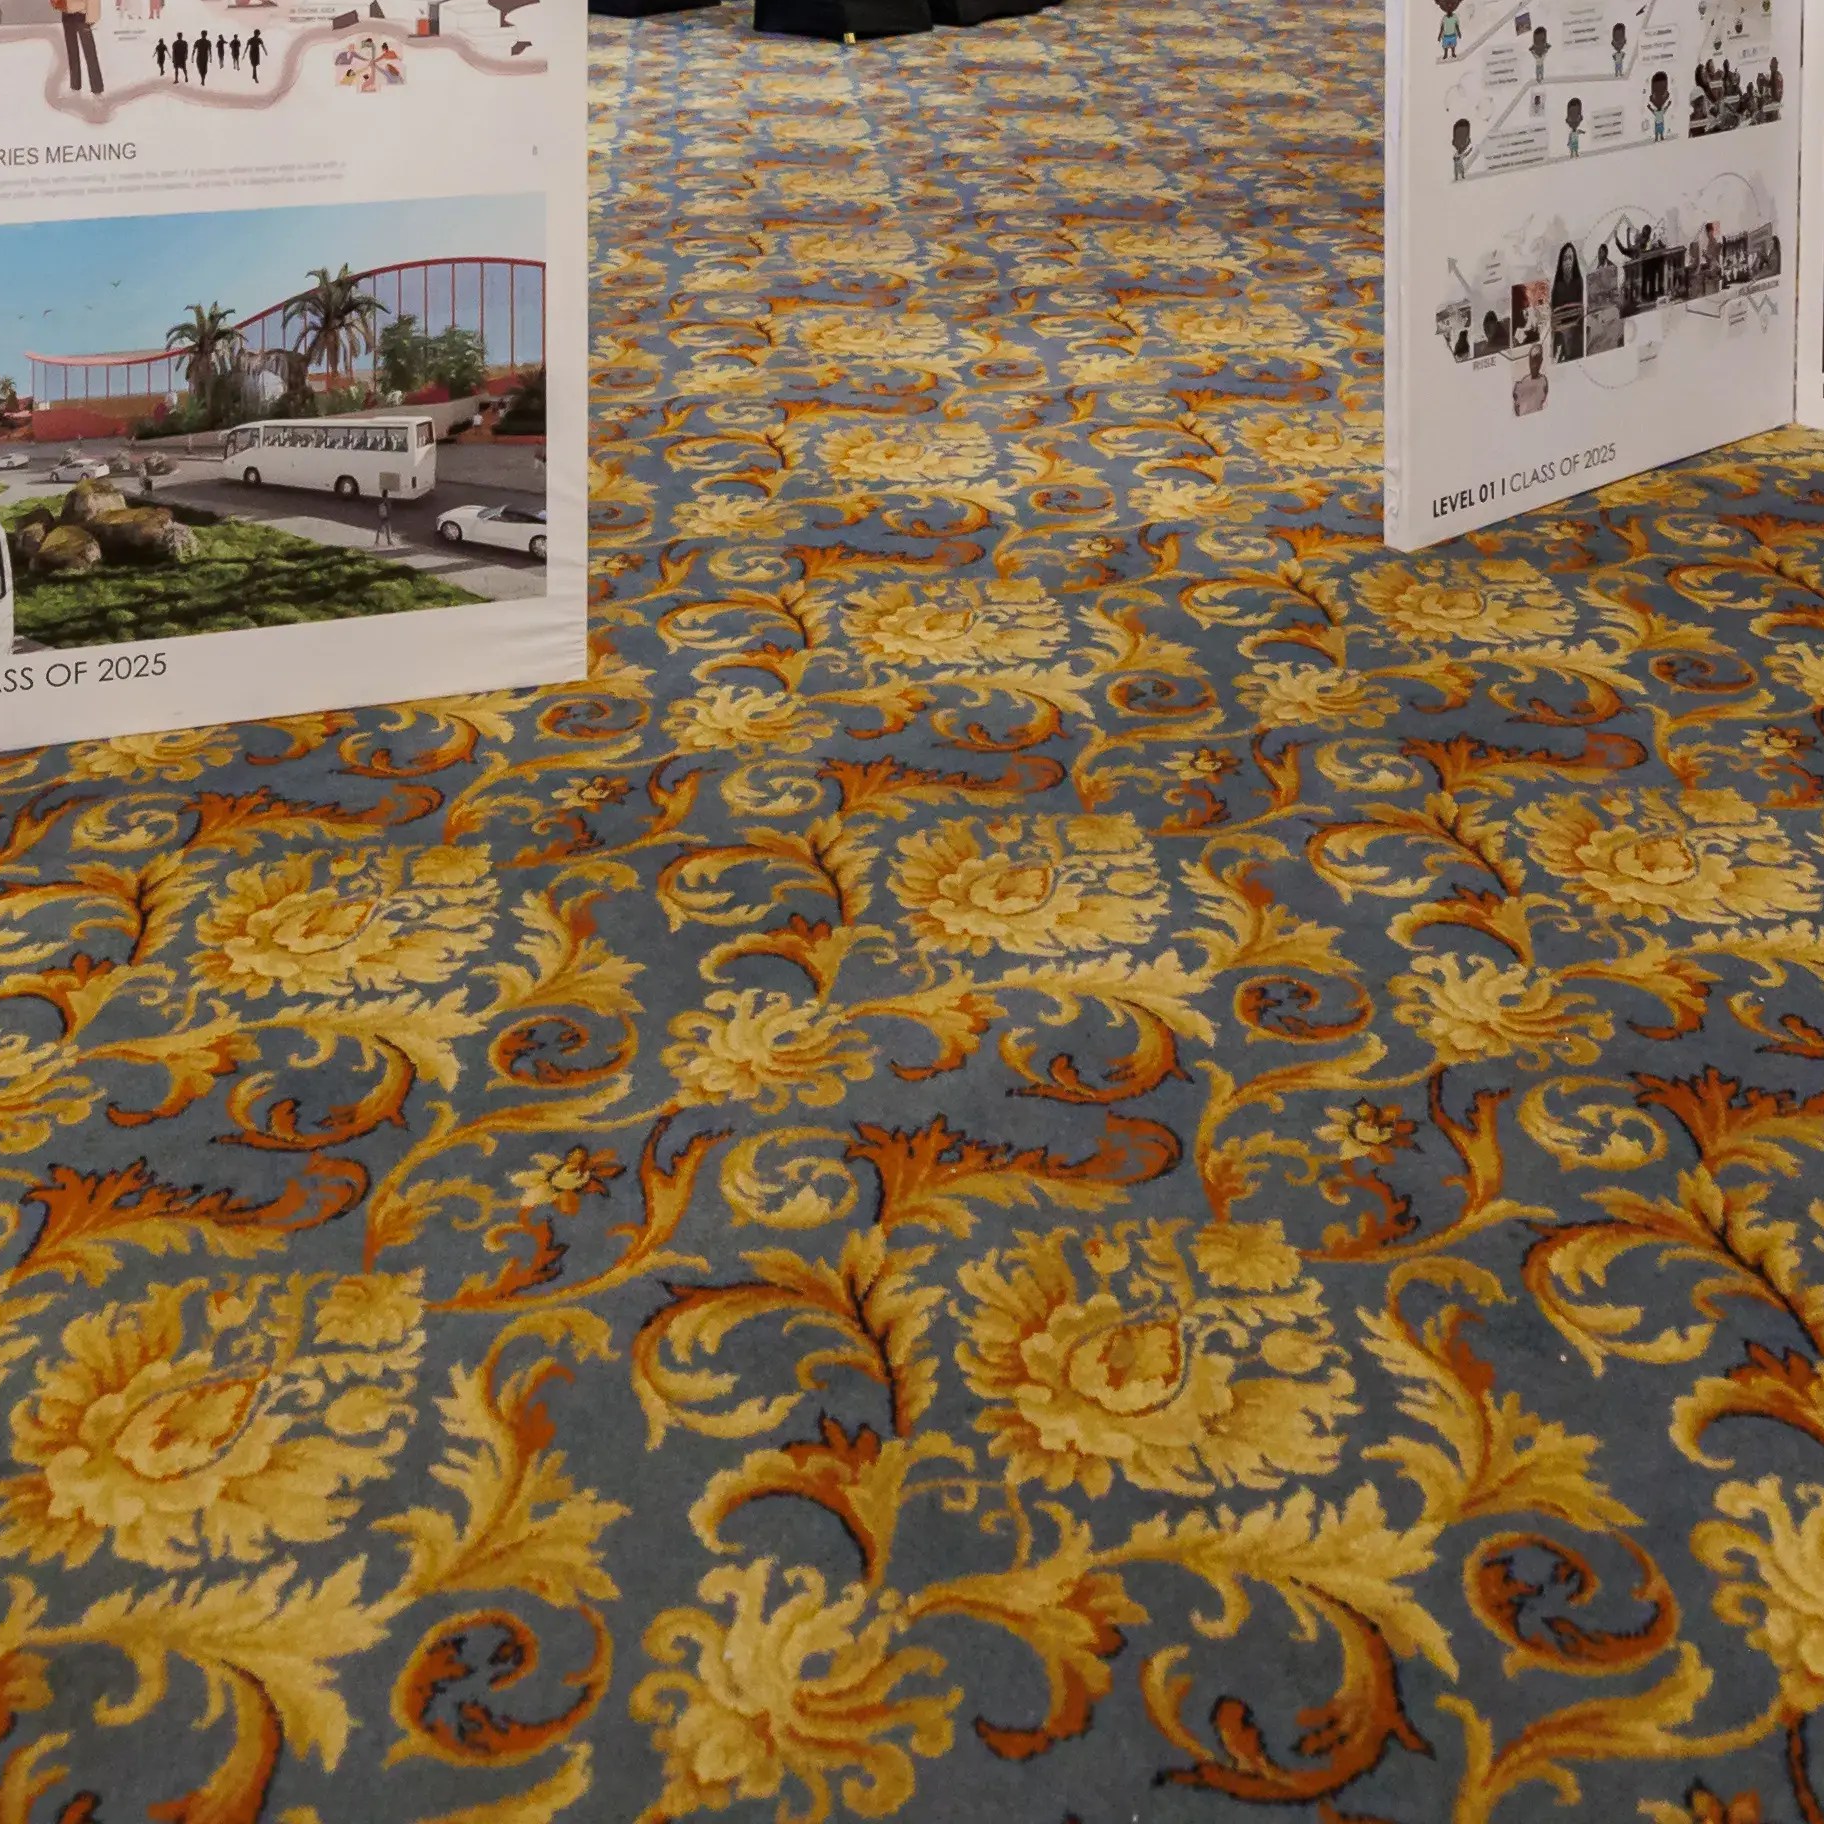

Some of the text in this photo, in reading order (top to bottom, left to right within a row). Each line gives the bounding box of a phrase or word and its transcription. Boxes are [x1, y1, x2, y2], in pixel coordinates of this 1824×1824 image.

[46, 142, 137, 164] MEANING
[1433, 488, 1475, 518] LEVEL
[1479, 481, 1495, 503] 01
[1509, 461, 1556, 492] CLASS
[1559, 454, 1580, 477] OF
[1584, 442, 1616, 469] 2025
[46, 660, 88, 688] OF
[98, 651, 168, 682] 2025
